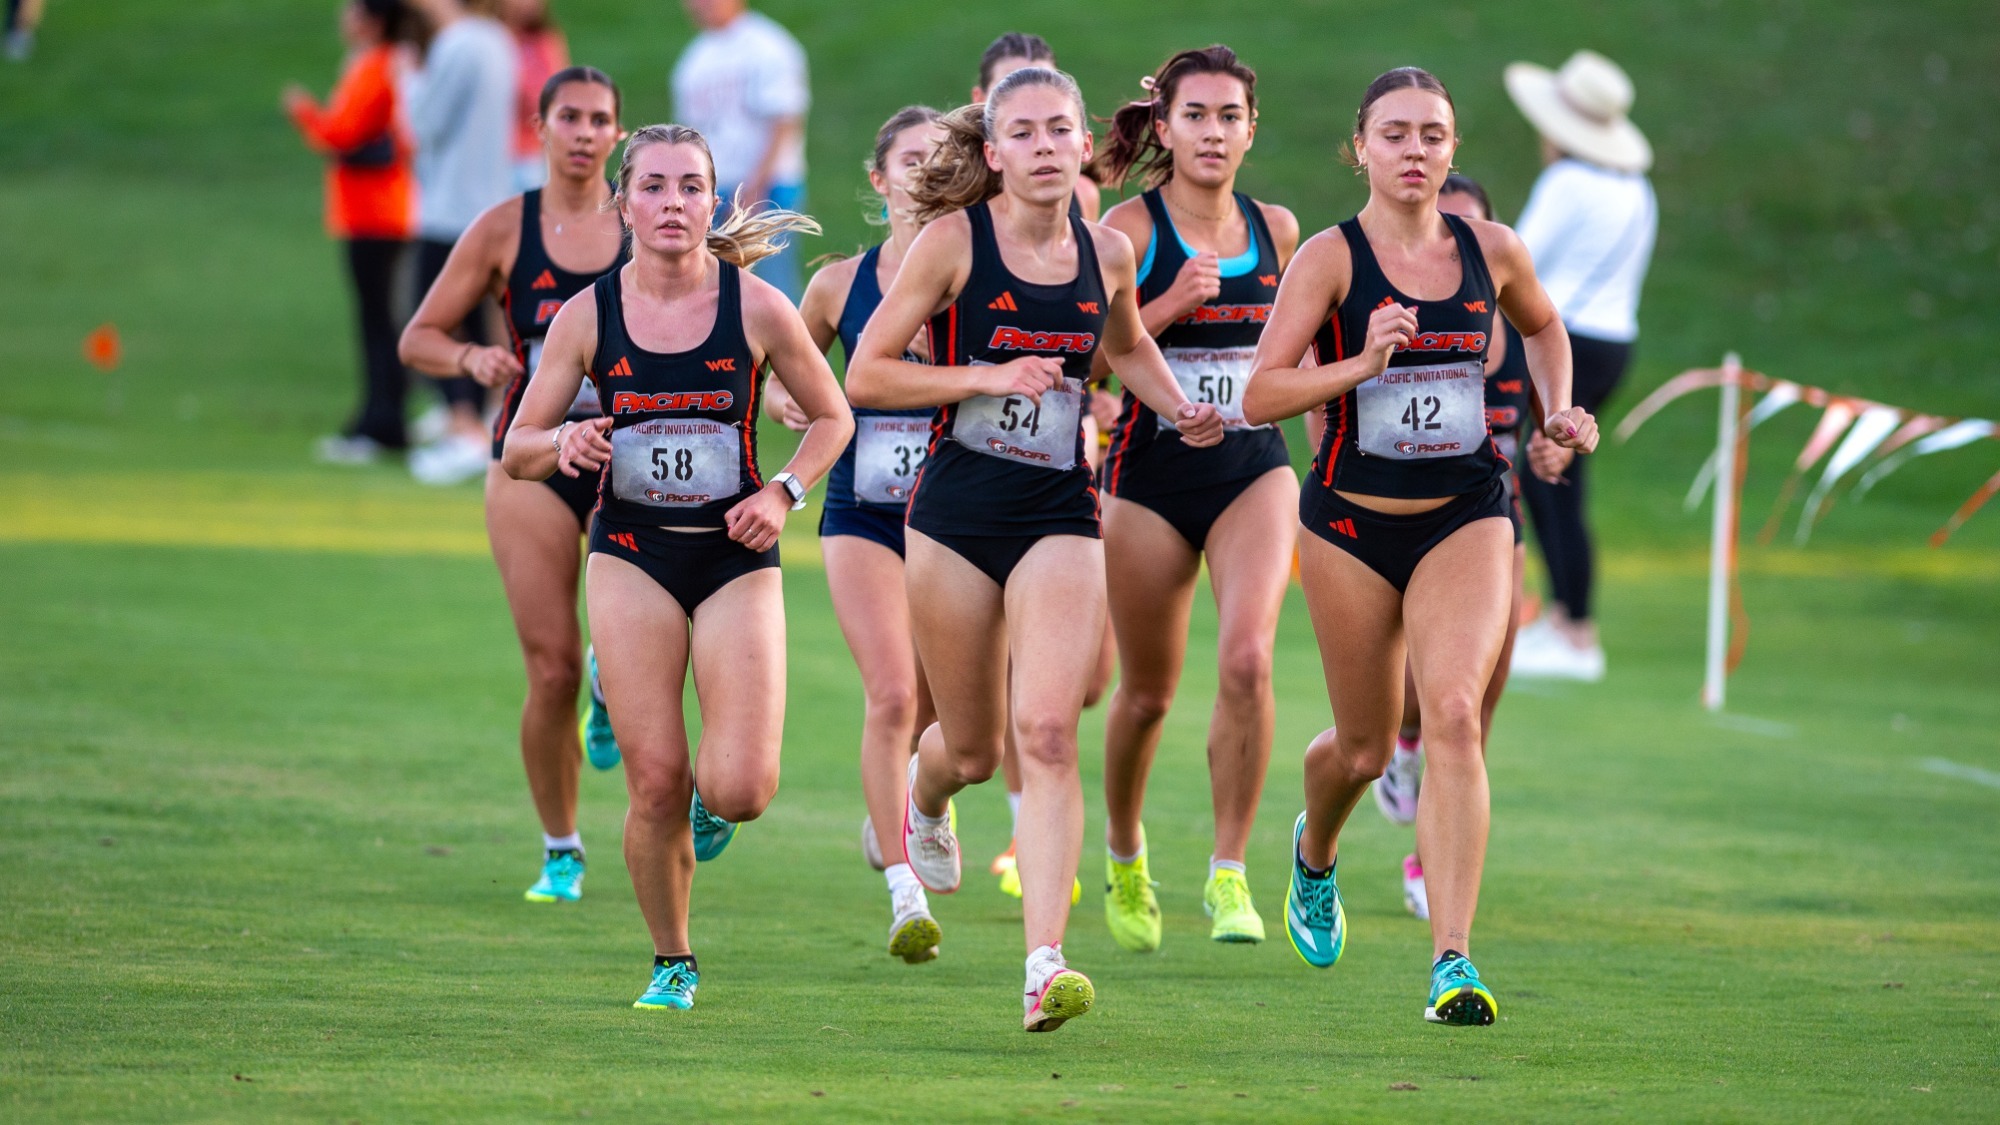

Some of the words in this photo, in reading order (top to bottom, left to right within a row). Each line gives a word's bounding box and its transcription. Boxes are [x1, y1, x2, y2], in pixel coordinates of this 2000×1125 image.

[1077, 302, 1100, 314] WCC
[1463, 301, 1488, 313] WCC
[988, 326, 1095, 353] PACIFIC
[705, 358, 736, 371] WCC
[1378, 372, 1411, 385] PACIFIC
[1413, 368, 1469, 384] INVITATIONAL
[1198, 375, 1232, 406] 50
[613, 390, 733, 414] PACIFIC
[999, 398, 1041, 436] 54
[1401, 395, 1442, 431] 42
[631, 424, 662, 435] PACIFIC
[664, 424, 723, 435] INVITATIONAL
[874, 422, 904, 433] PACIFIC
[1007, 446, 1051, 462] PACIFIC
[1417, 442, 1461, 453] PACIFIC
[652, 448, 693, 481] 58
[894, 445, 928, 477] 32
[666, 493, 710, 502] PACIFIC
